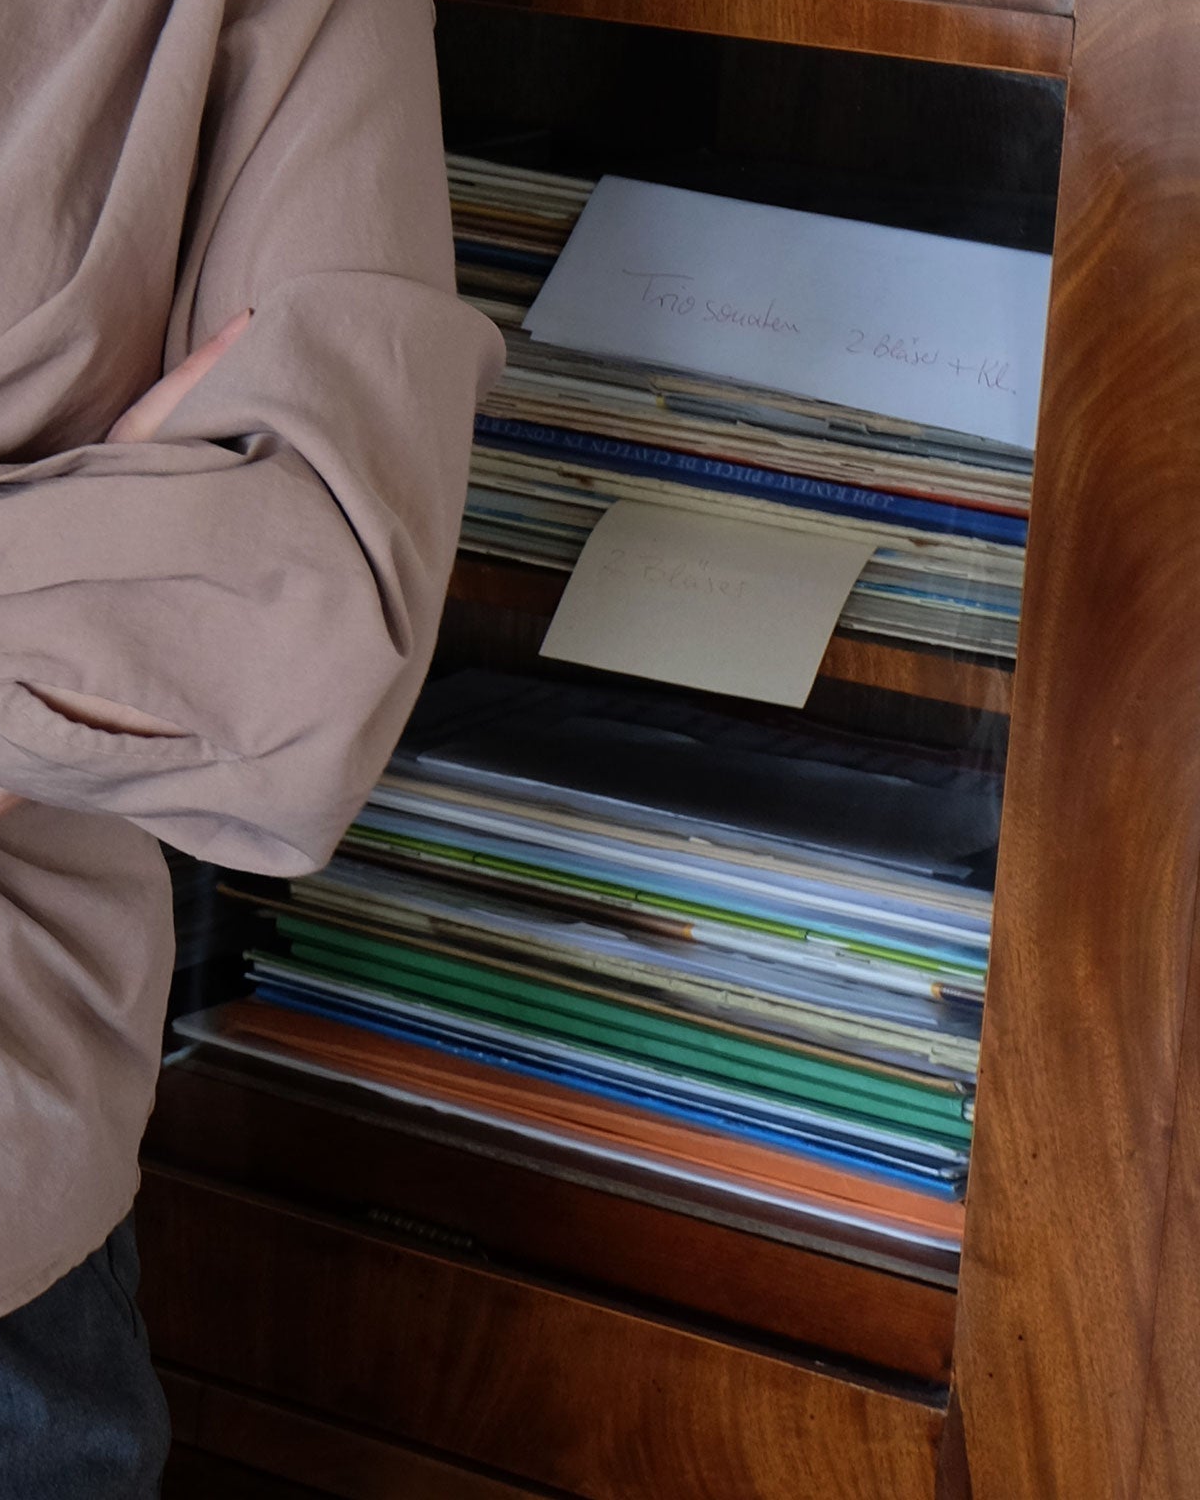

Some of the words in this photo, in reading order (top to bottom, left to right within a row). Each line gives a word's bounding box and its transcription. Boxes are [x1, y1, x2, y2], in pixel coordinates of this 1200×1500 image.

[846, 328, 864, 354] 2
[589, 435, 671, 467] CLAVECIN
[677, 453, 698, 472] DE
